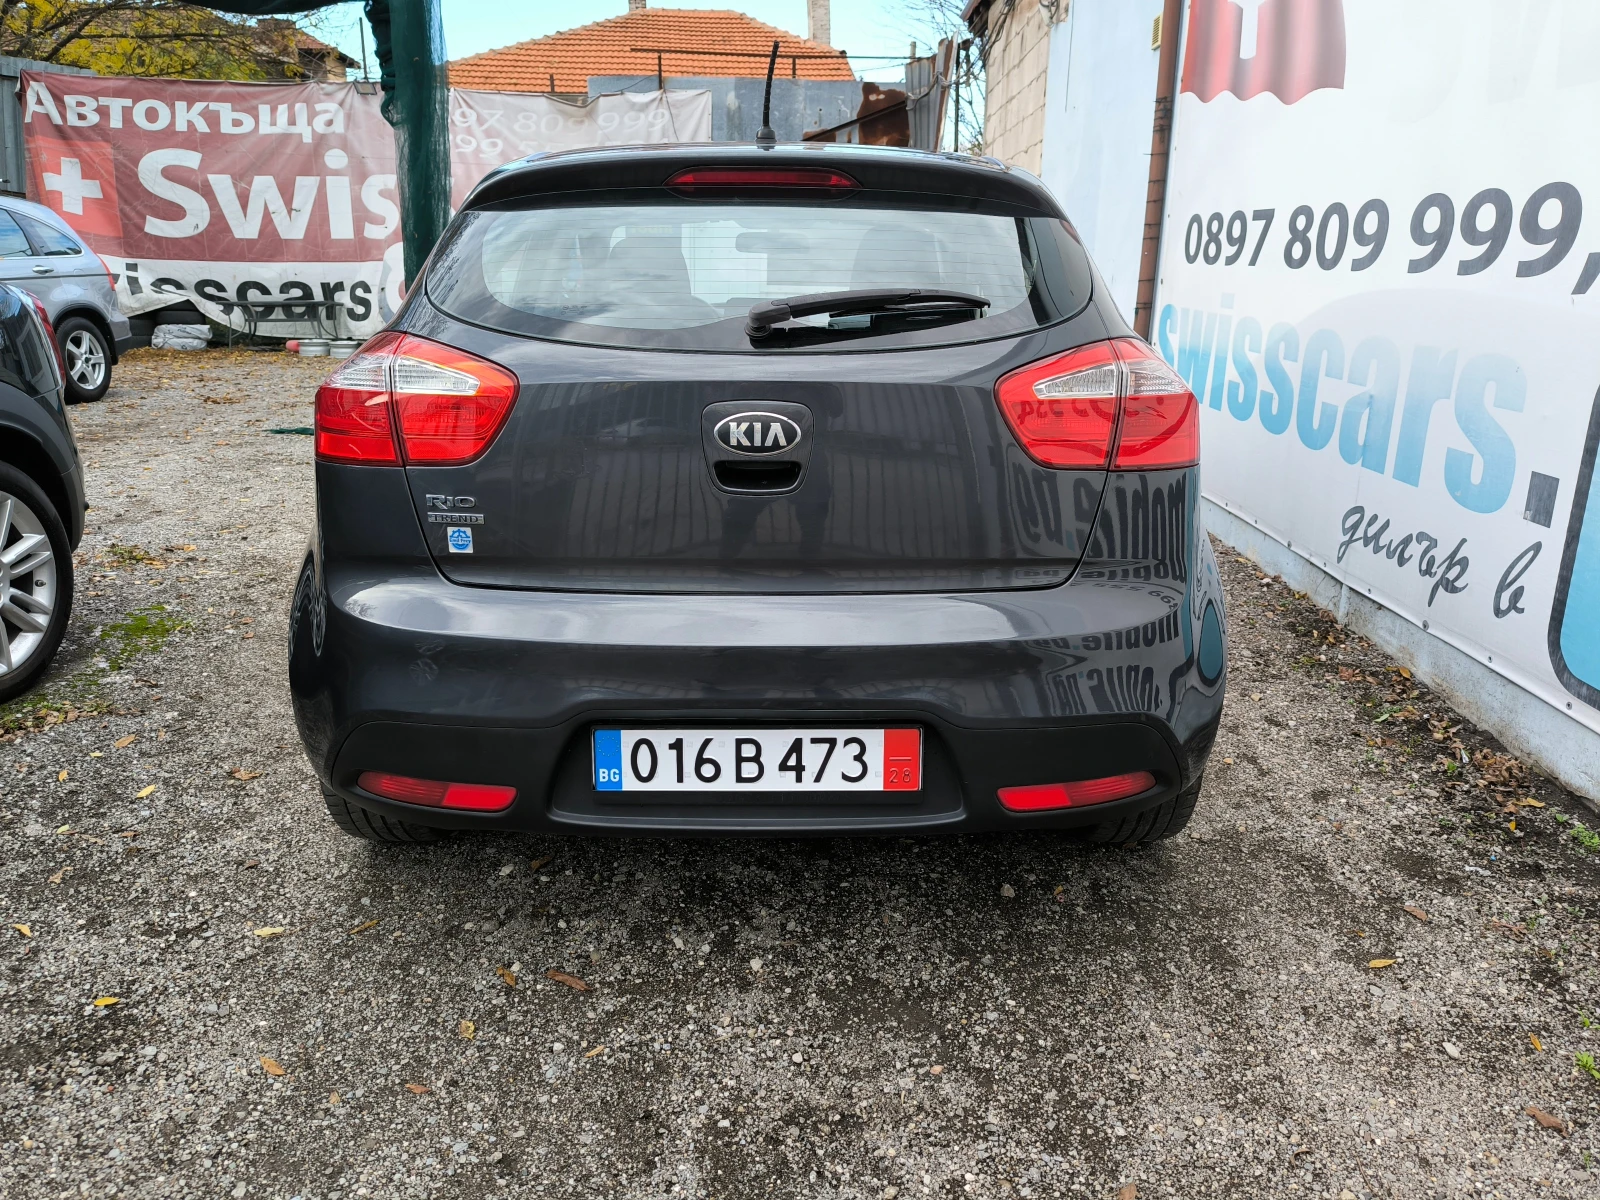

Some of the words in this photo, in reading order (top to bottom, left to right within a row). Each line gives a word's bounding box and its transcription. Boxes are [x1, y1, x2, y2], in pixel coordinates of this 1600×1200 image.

[24, 80, 345, 143] Автокъща
[597, 108, 670, 133] 999
[449, 133, 503, 158] 99
[137, 147, 400, 241] Swis
[1185, 208, 1275, 267] 0897
[1283, 199, 1390, 271] 809
[107, 262, 373, 323] isscars
[729, 421, 788, 447] KIA
[430, 513, 481, 523] TREND
[630, 737, 722, 784] 016
[735, 737, 765, 784] B
[778, 736, 869, 784] 473
[599, 768, 620, 783] BG
[888, 767, 912, 783] 28
